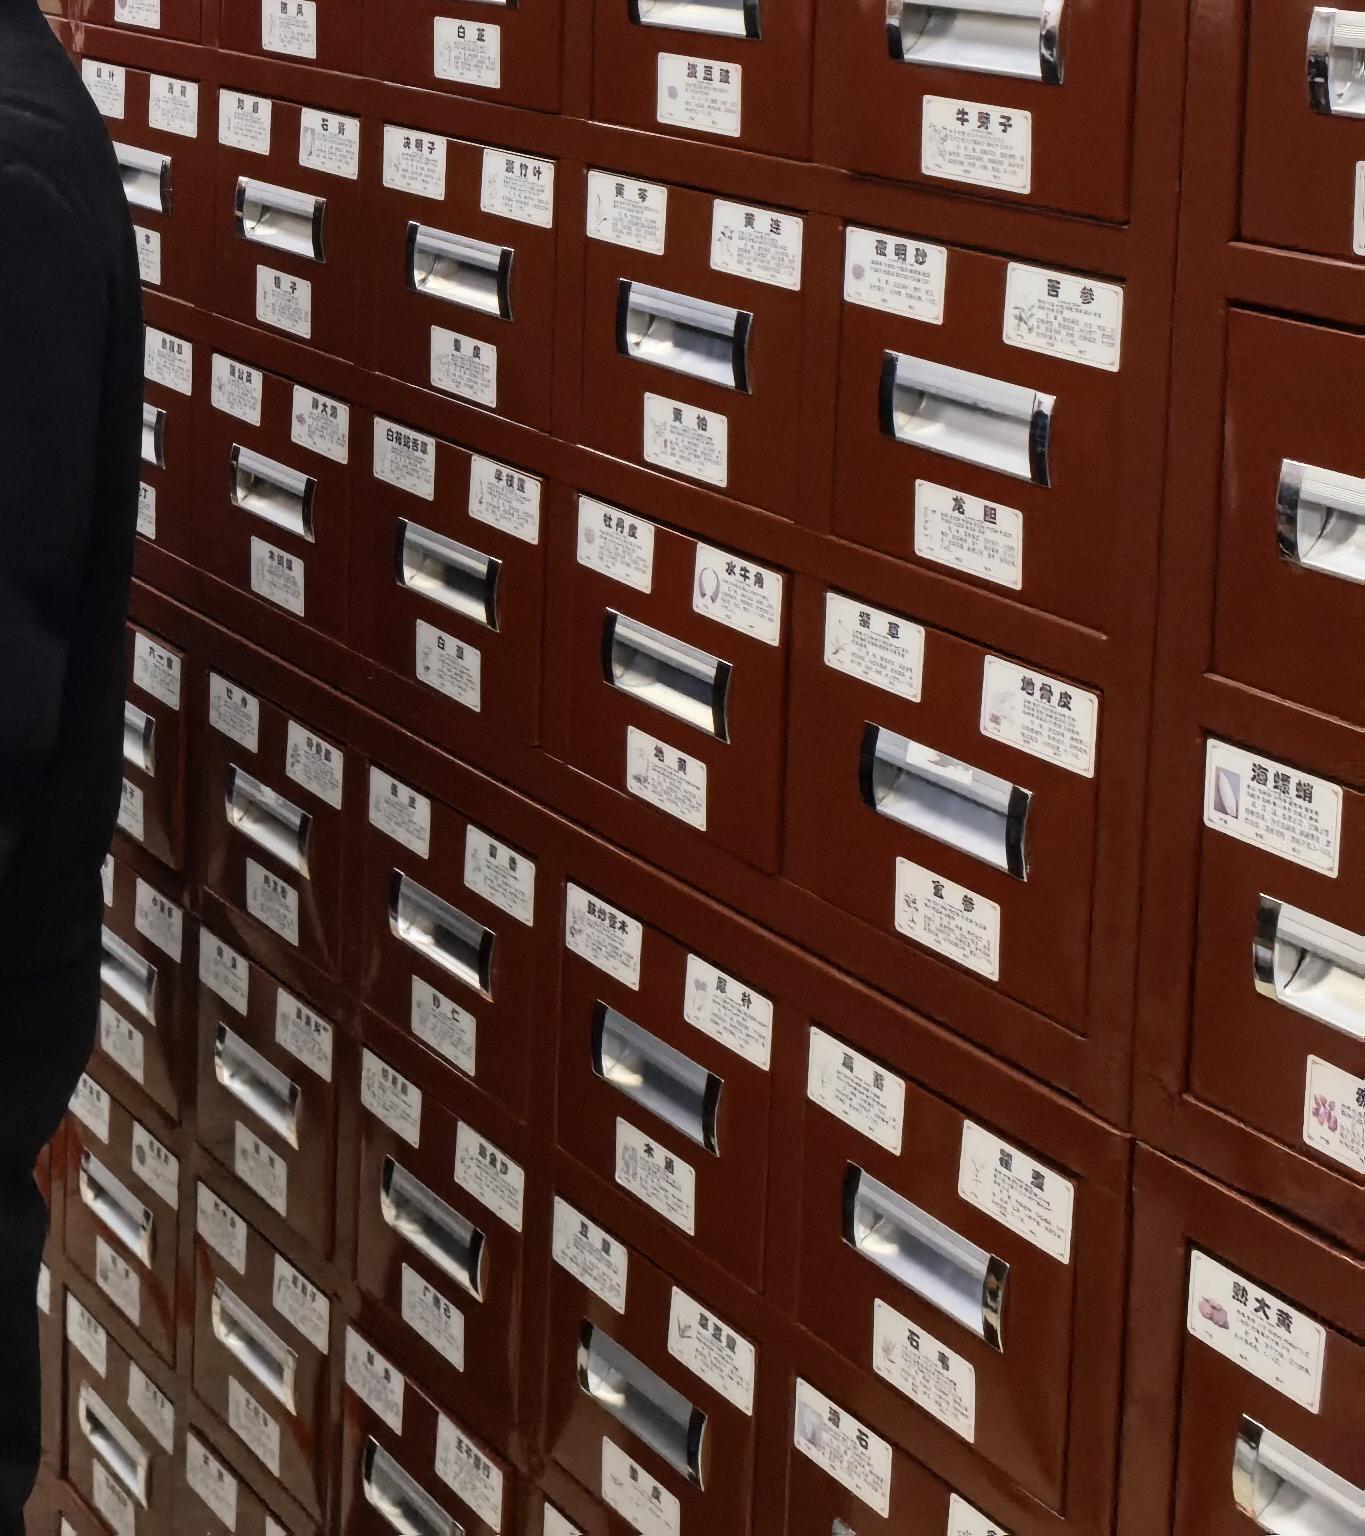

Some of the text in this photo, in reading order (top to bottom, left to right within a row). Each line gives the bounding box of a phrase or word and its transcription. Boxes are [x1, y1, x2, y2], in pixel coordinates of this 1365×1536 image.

[955, 107, 1013, 134] 牛蒡子
[403, 136, 436, 155] 决明子
[614, 182, 648, 203] 黄芩
[744, 212, 782, 236] 黄连
[874, 239, 928, 267] 夜明砂
[1046, 278, 1095, 305] 苦参
[672, 407, 708, 432] 黄柏
[386, 427, 429, 455] 白花蛇舌草
[951, 495, 998, 526] 龙胆
[603, 513, 638, 540] 牡丹皮
[725, 560, 764, 589] 水牛角
[1020, 675, 1073, 712] 地骨皮
[653, 744, 687, 776] 地黄
[1250, 762, 1314, 804] 海螵蛸
[1231, 1281, 1293, 1335] 熟大黄
